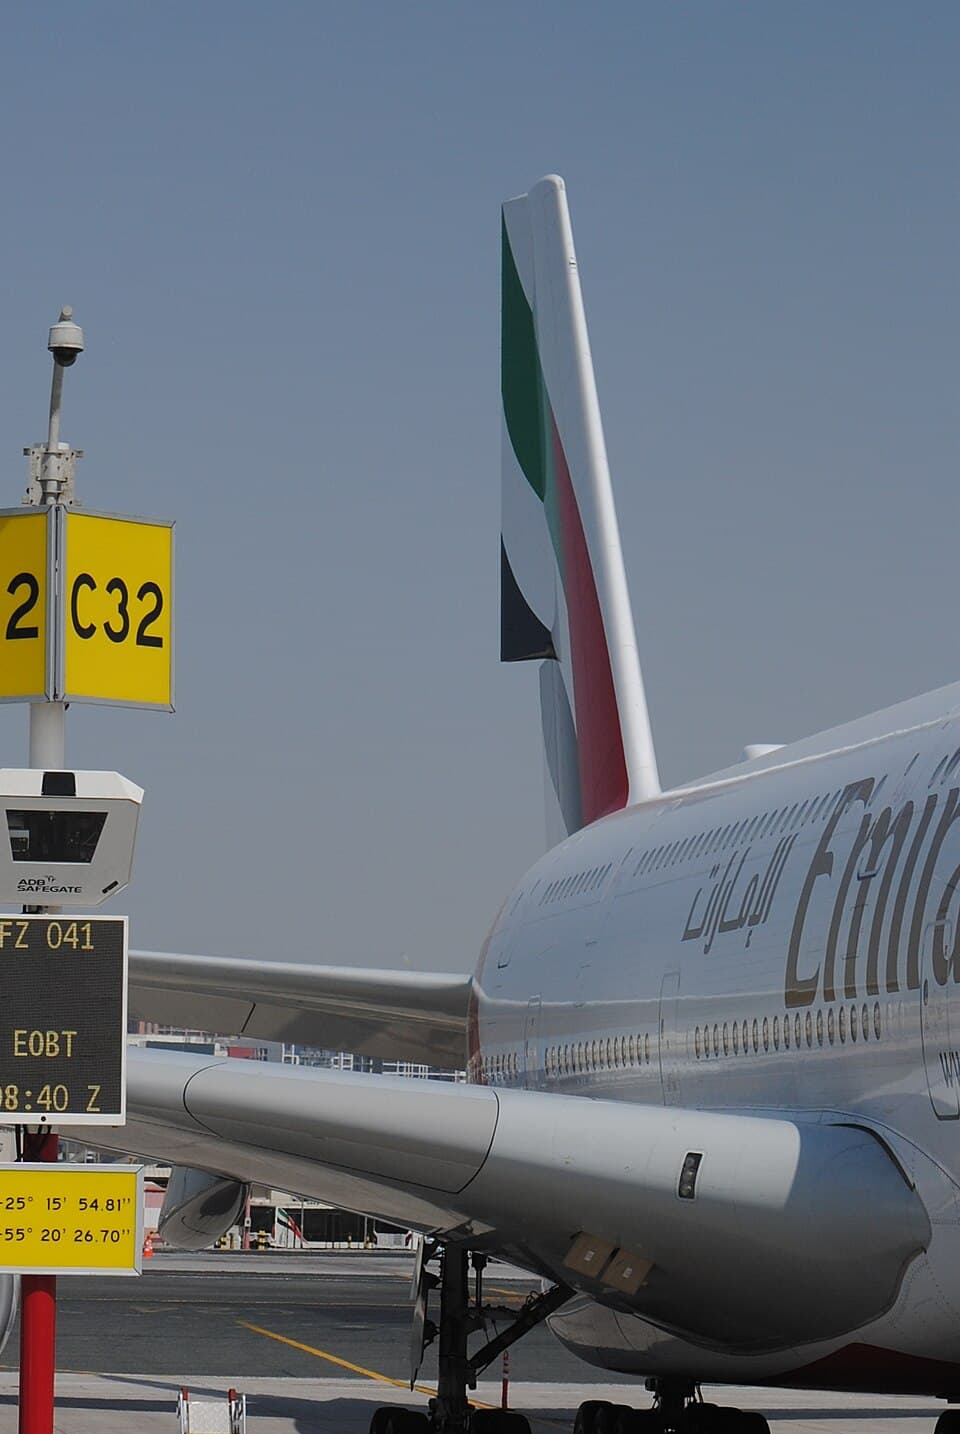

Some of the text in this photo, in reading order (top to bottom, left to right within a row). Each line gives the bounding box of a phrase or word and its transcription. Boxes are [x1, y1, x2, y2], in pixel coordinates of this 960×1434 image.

[71, 573, 164, 648] C32
[17, 885, 82, 893] SAFEGATE
[18, 878, 46, 886] ADB
[0, 921, 94, 950] FZ 041
[14, 1030, 77, 1057] EOBT
[86, 1085, 101, 1112] Z
